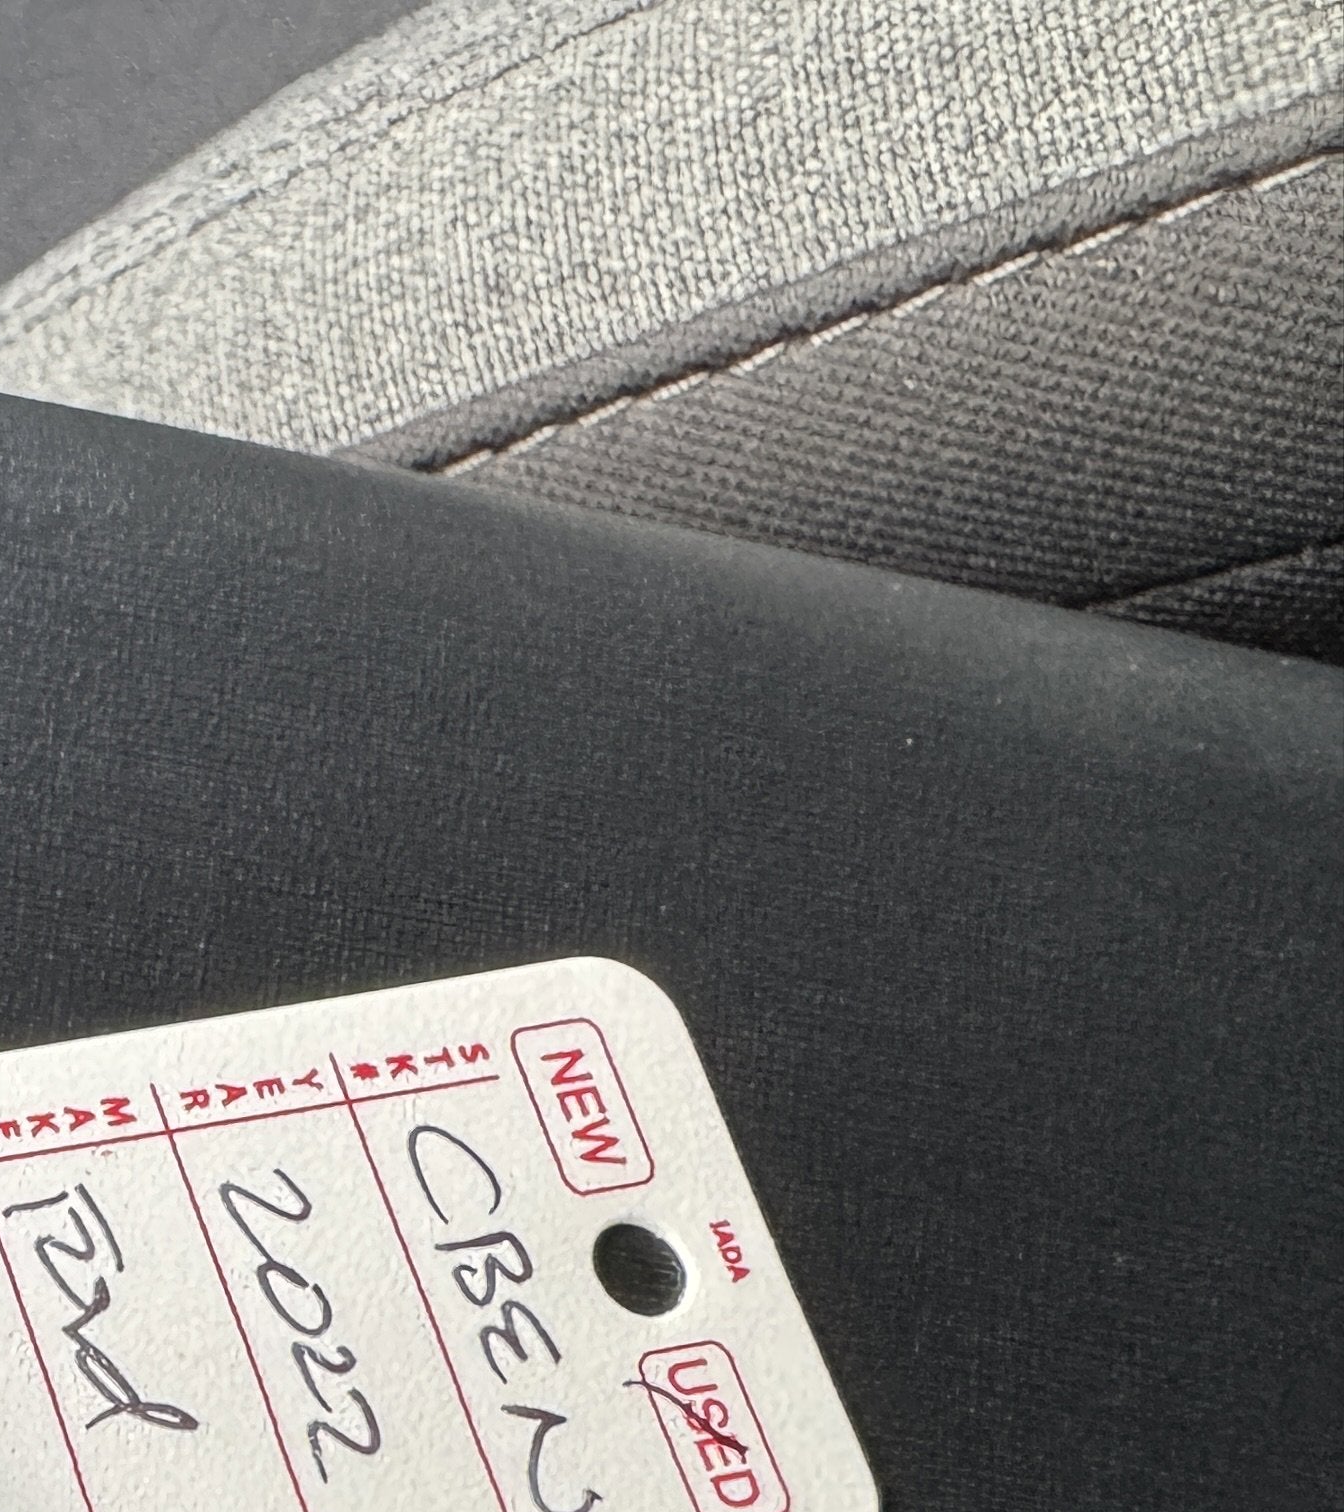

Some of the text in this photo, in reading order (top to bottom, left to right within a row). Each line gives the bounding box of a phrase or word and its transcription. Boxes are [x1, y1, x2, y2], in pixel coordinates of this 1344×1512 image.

[180, 1068, 322, 1112] YEAR
[350, 1043, 491, 1081] STK#
[541, 1046, 627, 1168] NEW
[218, 1167, 382, 1483] 2022
[666, 1357, 761, 1511] USED
